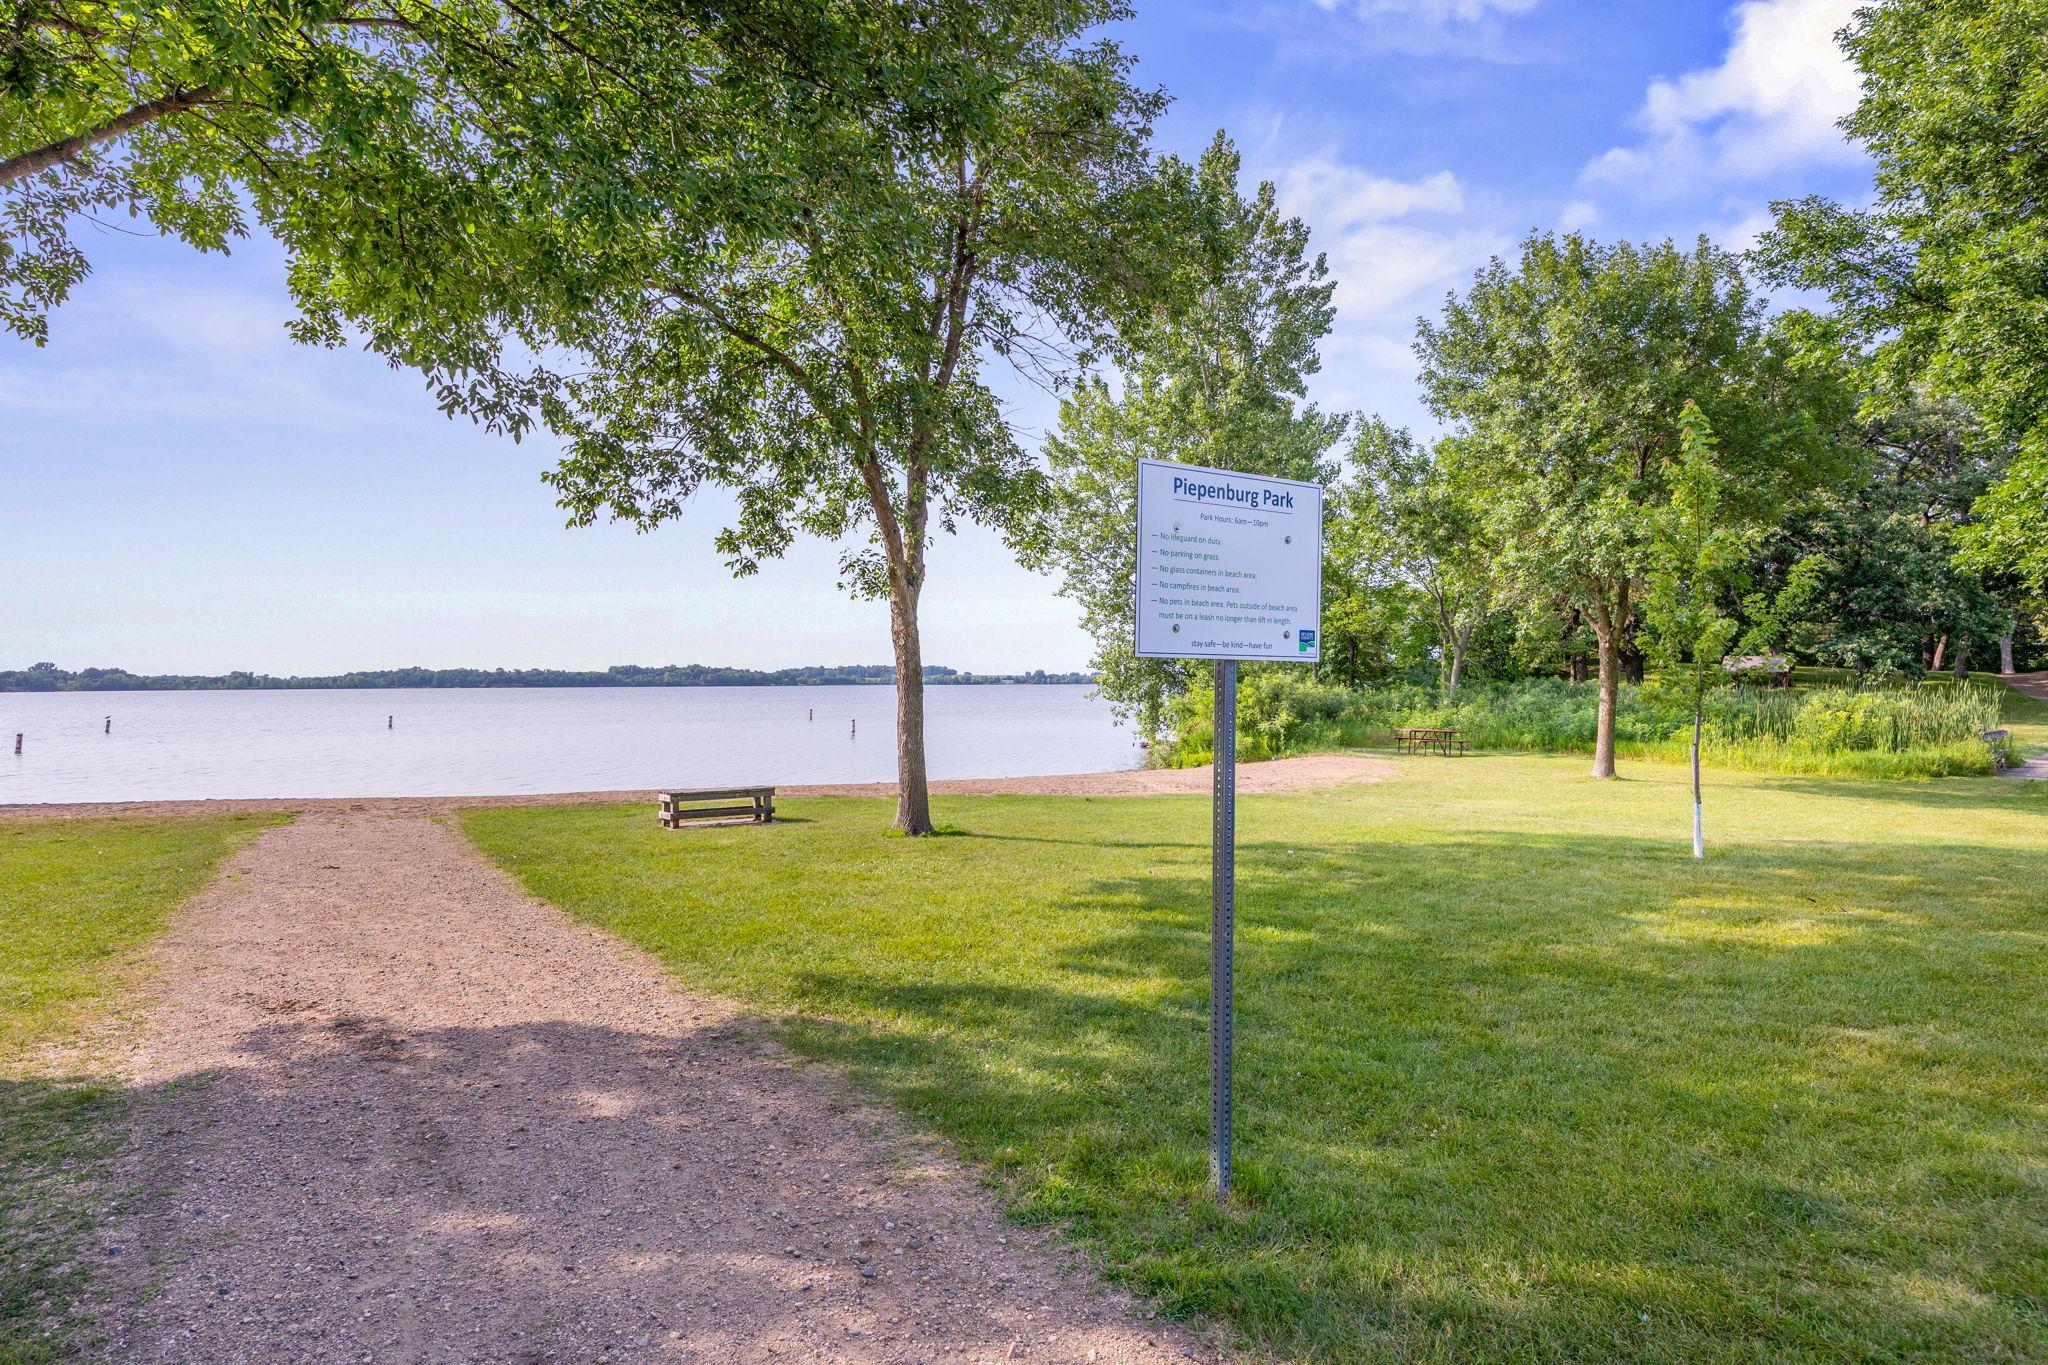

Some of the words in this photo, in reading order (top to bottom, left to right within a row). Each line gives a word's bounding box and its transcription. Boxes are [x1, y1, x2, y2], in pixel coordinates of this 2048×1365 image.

[1173, 476, 1259, 507] Piepenburg
[1263, 489, 1293, 508] Park
[1200, 512, 1213, 521] Park
[1214, 515, 1233, 524] Hours:
[1160, 532, 1169, 541] No
[1170, 533, 1197, 543] lifeguard
[1160, 548, 1169, 556] No
[1170, 549, 1193, 560] parking
[1159, 564, 1169, 573] No
[1170, 565, 1185, 575] glass
[1186, 567, 1217, 577] containers
[1218, 569, 1224, 577] in
[1225, 570, 1243, 578] beach
[1159, 581, 1169, 589] No
[1170, 582, 1199, 591] campfires
[1207, 584, 1226, 592] beach
[1169, 598, 1183, 606] pets
[1191, 598, 1209, 607] beach
[1226, 601, 1239, 609] Pets
[1239, 602, 1260, 610] outside
[1261, 603, 1268, 611] of
[1268, 604, 1285, 612] beach
[1158, 612, 1174, 620] must
[1175, 612, 1184, 620] be
[1199, 612, 1215, 621] leash
[1224, 613, 1243, 623] longer
[1257, 616, 1266, 624] 6ft
[1191, 640, 1203, 649] stay
[1263, 641, 1273, 650] fun
